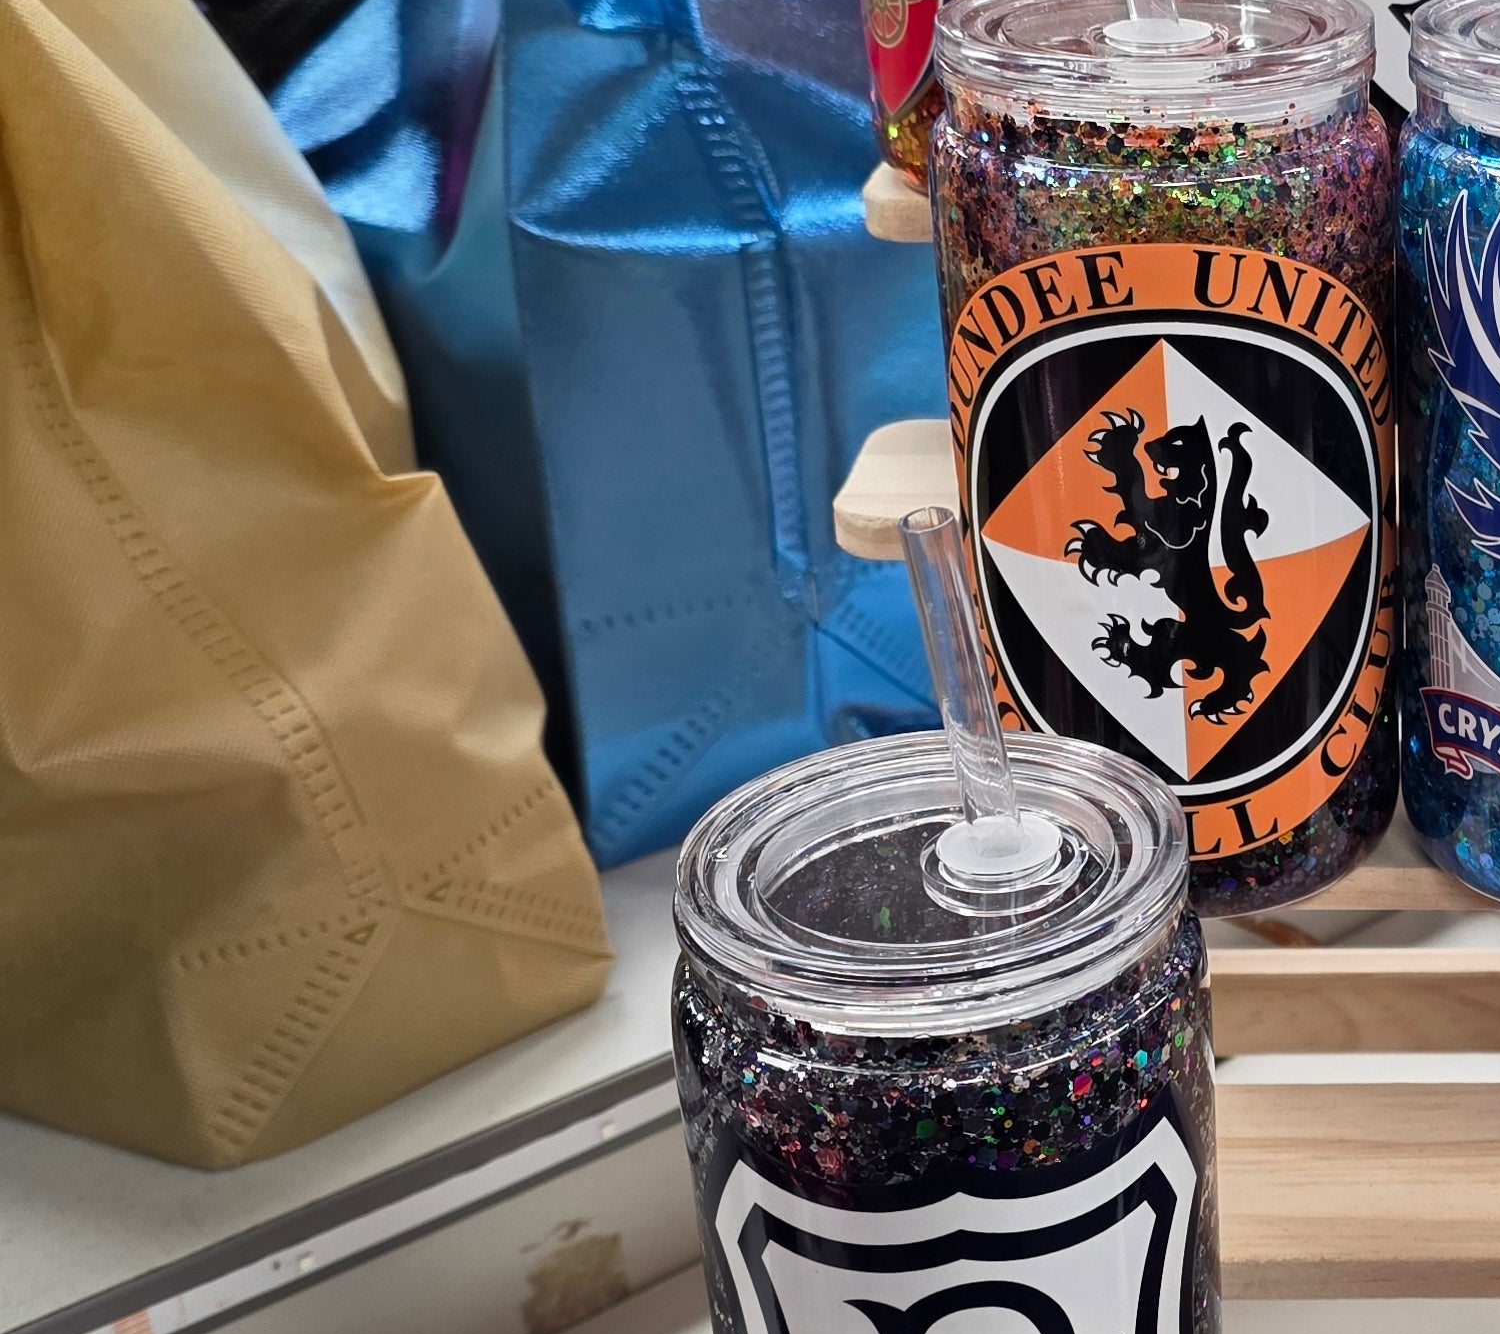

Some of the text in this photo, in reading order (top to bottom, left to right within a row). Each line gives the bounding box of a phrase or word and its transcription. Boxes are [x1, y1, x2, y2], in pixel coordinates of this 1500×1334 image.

[951, 249, 1391, 463] DUNDEE UNITED
[1320, 569, 1396, 778] CLUB
